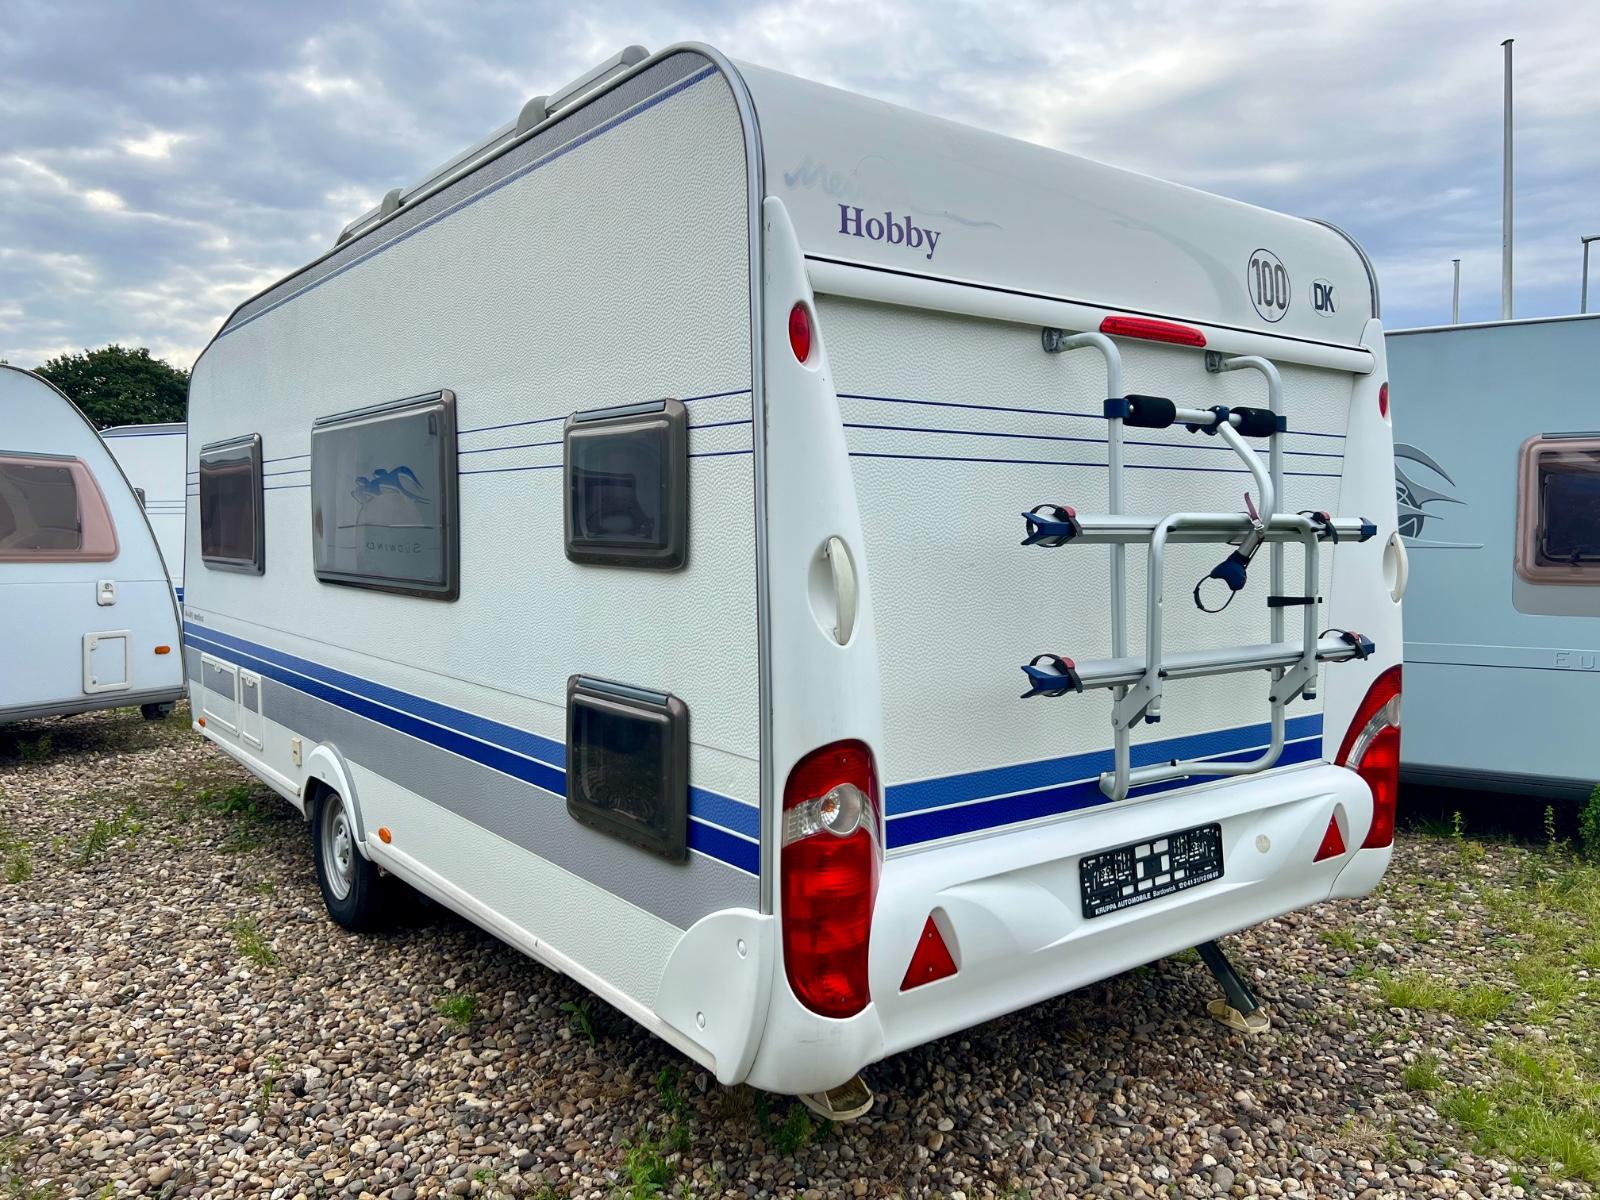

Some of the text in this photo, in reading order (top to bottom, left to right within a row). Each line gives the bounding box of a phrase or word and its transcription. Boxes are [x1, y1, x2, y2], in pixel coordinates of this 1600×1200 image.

[837, 203, 942, 260] Hobby
[1251, 258, 1287, 310] 100
[1313, 282, 1336, 313] DK
[1118, 893, 1151, 908] AUTOMOBILE
